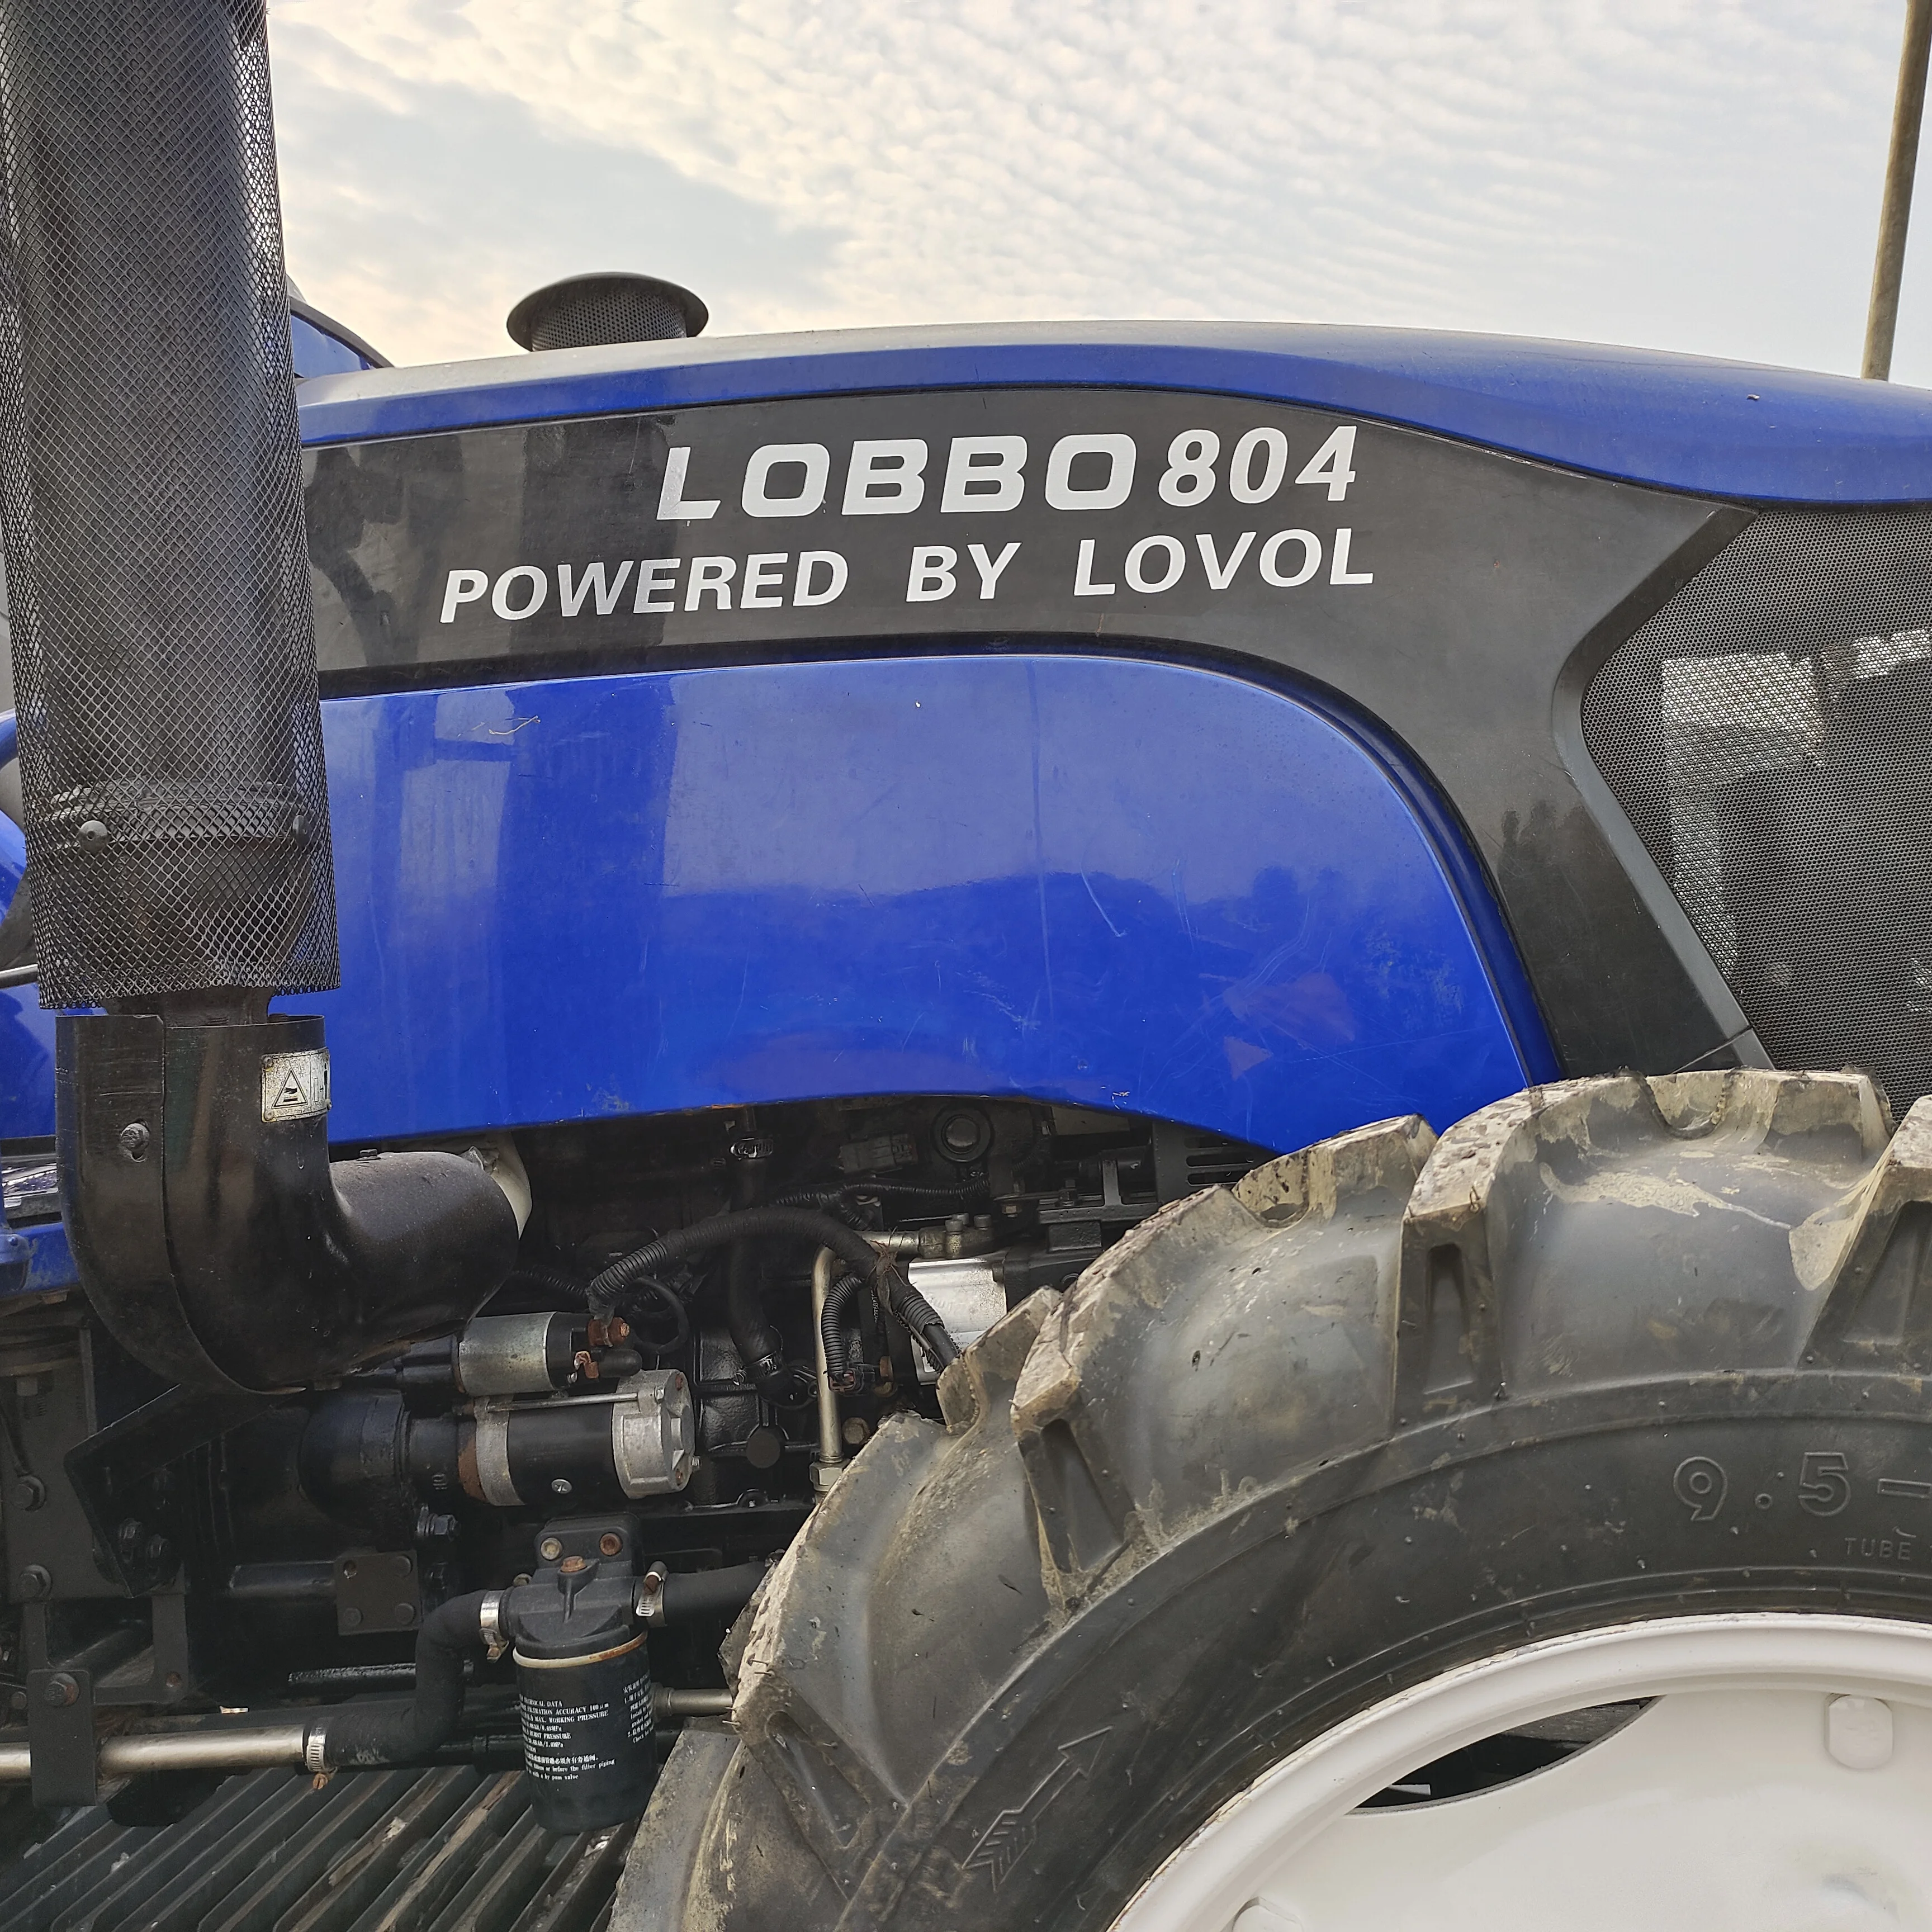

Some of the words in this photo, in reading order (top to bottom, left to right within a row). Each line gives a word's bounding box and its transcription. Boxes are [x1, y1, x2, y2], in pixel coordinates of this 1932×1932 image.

[656, 433, 1137, 520] LOBBO
[1158, 425, 1357, 507] 804
[440, 551, 848, 623] POWERED
[906, 542, 1022, 602] BY
[1073, 528, 1374, 596] LOVOL
[1844, 1537, 1912, 1561] TUBE
[555, 1706, 587, 1715] ACCURACY
[577, 1709, 609, 1722] PRESSURE
[581, 1762, 596, 1771] filter
[598, 1759, 615, 1770] piping
